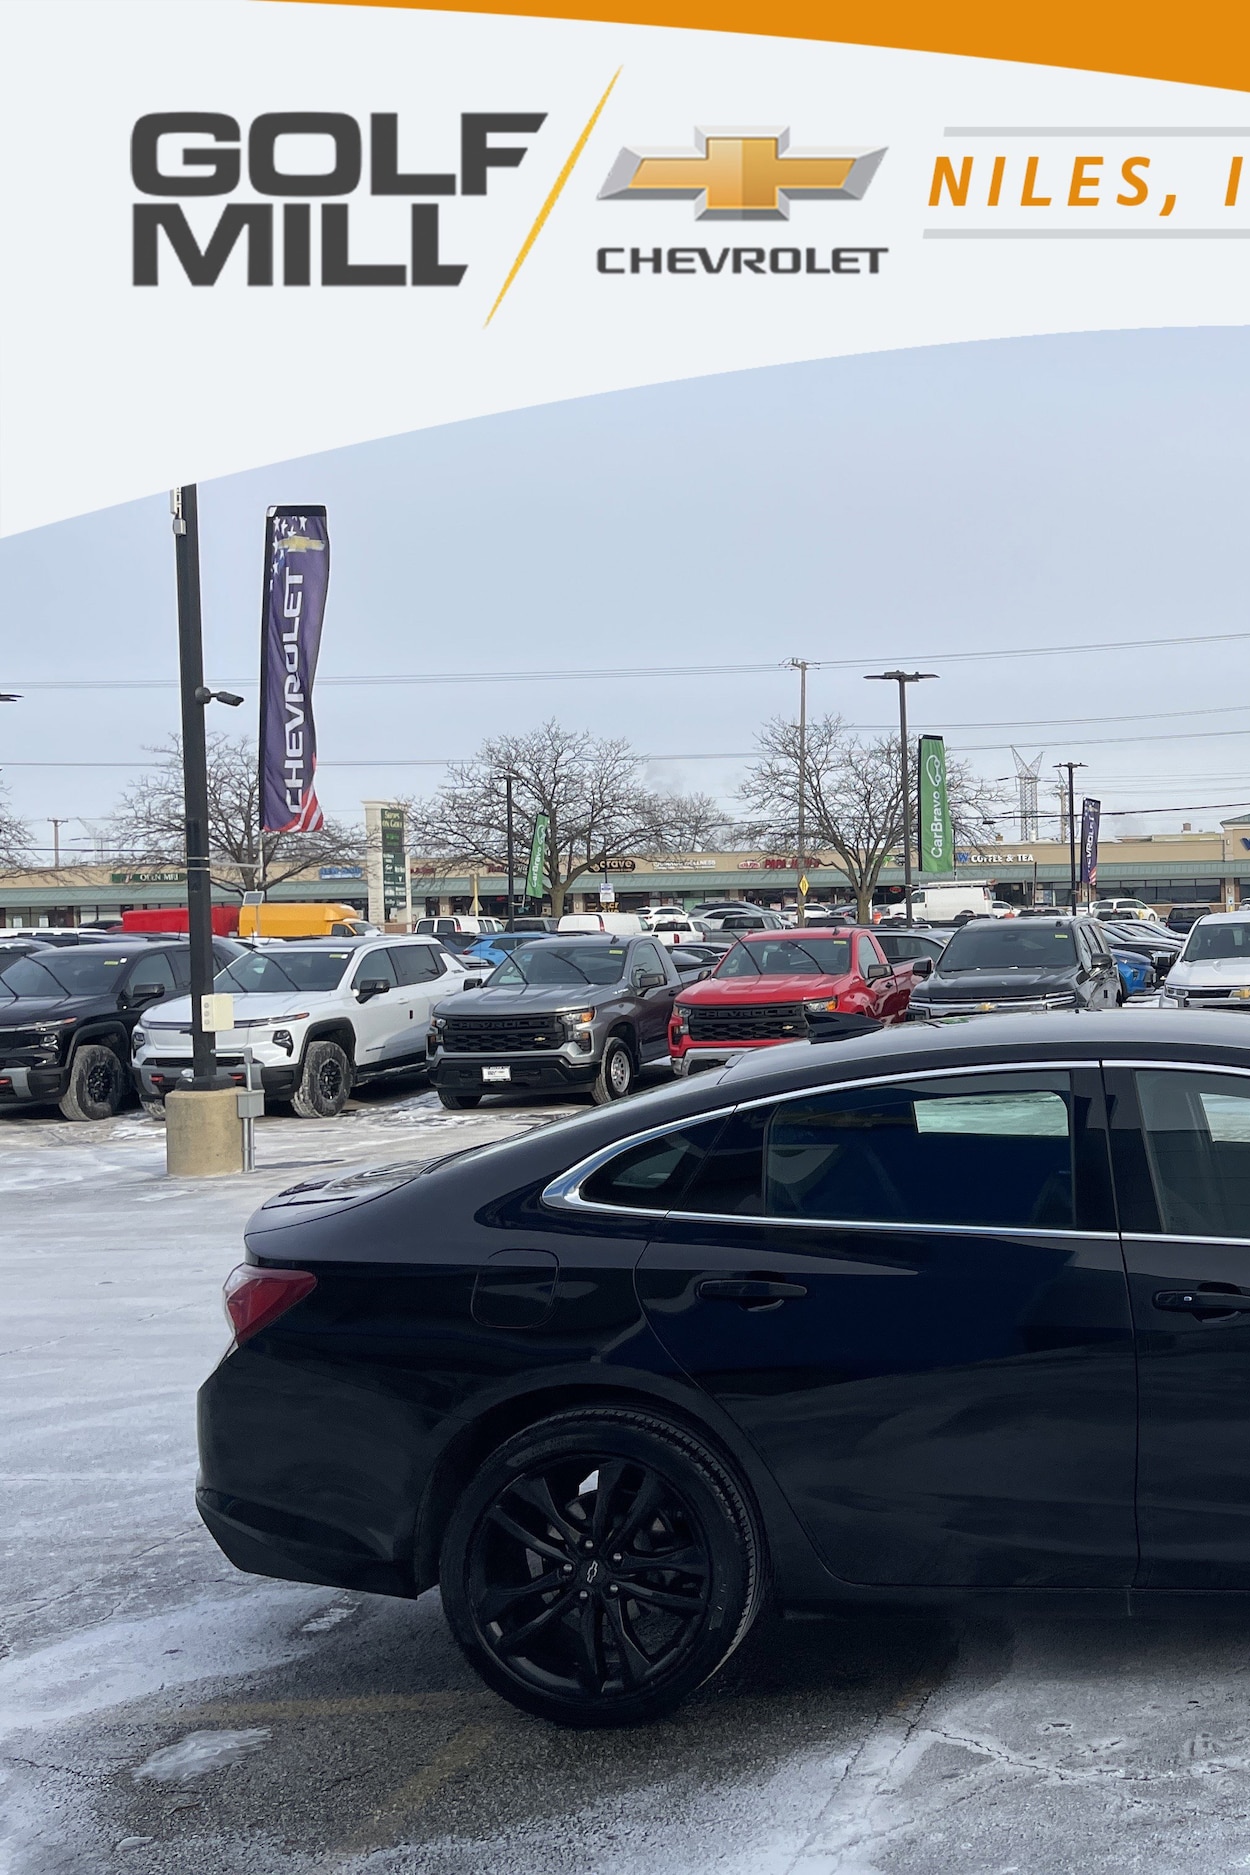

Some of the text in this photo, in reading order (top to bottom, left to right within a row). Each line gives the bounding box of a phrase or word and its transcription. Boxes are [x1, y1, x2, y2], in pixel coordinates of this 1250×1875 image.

[283, 566, 304, 815] CHEVROLET
[930, 790, 943, 858] CarBravo
[532, 847, 542, 888] CarBravo
[600, 859, 633, 868] crave
[971, 854, 1002, 863] COFFEE
[1006, 854, 1014, 862] &
[1017, 854, 1034, 862] TEA
